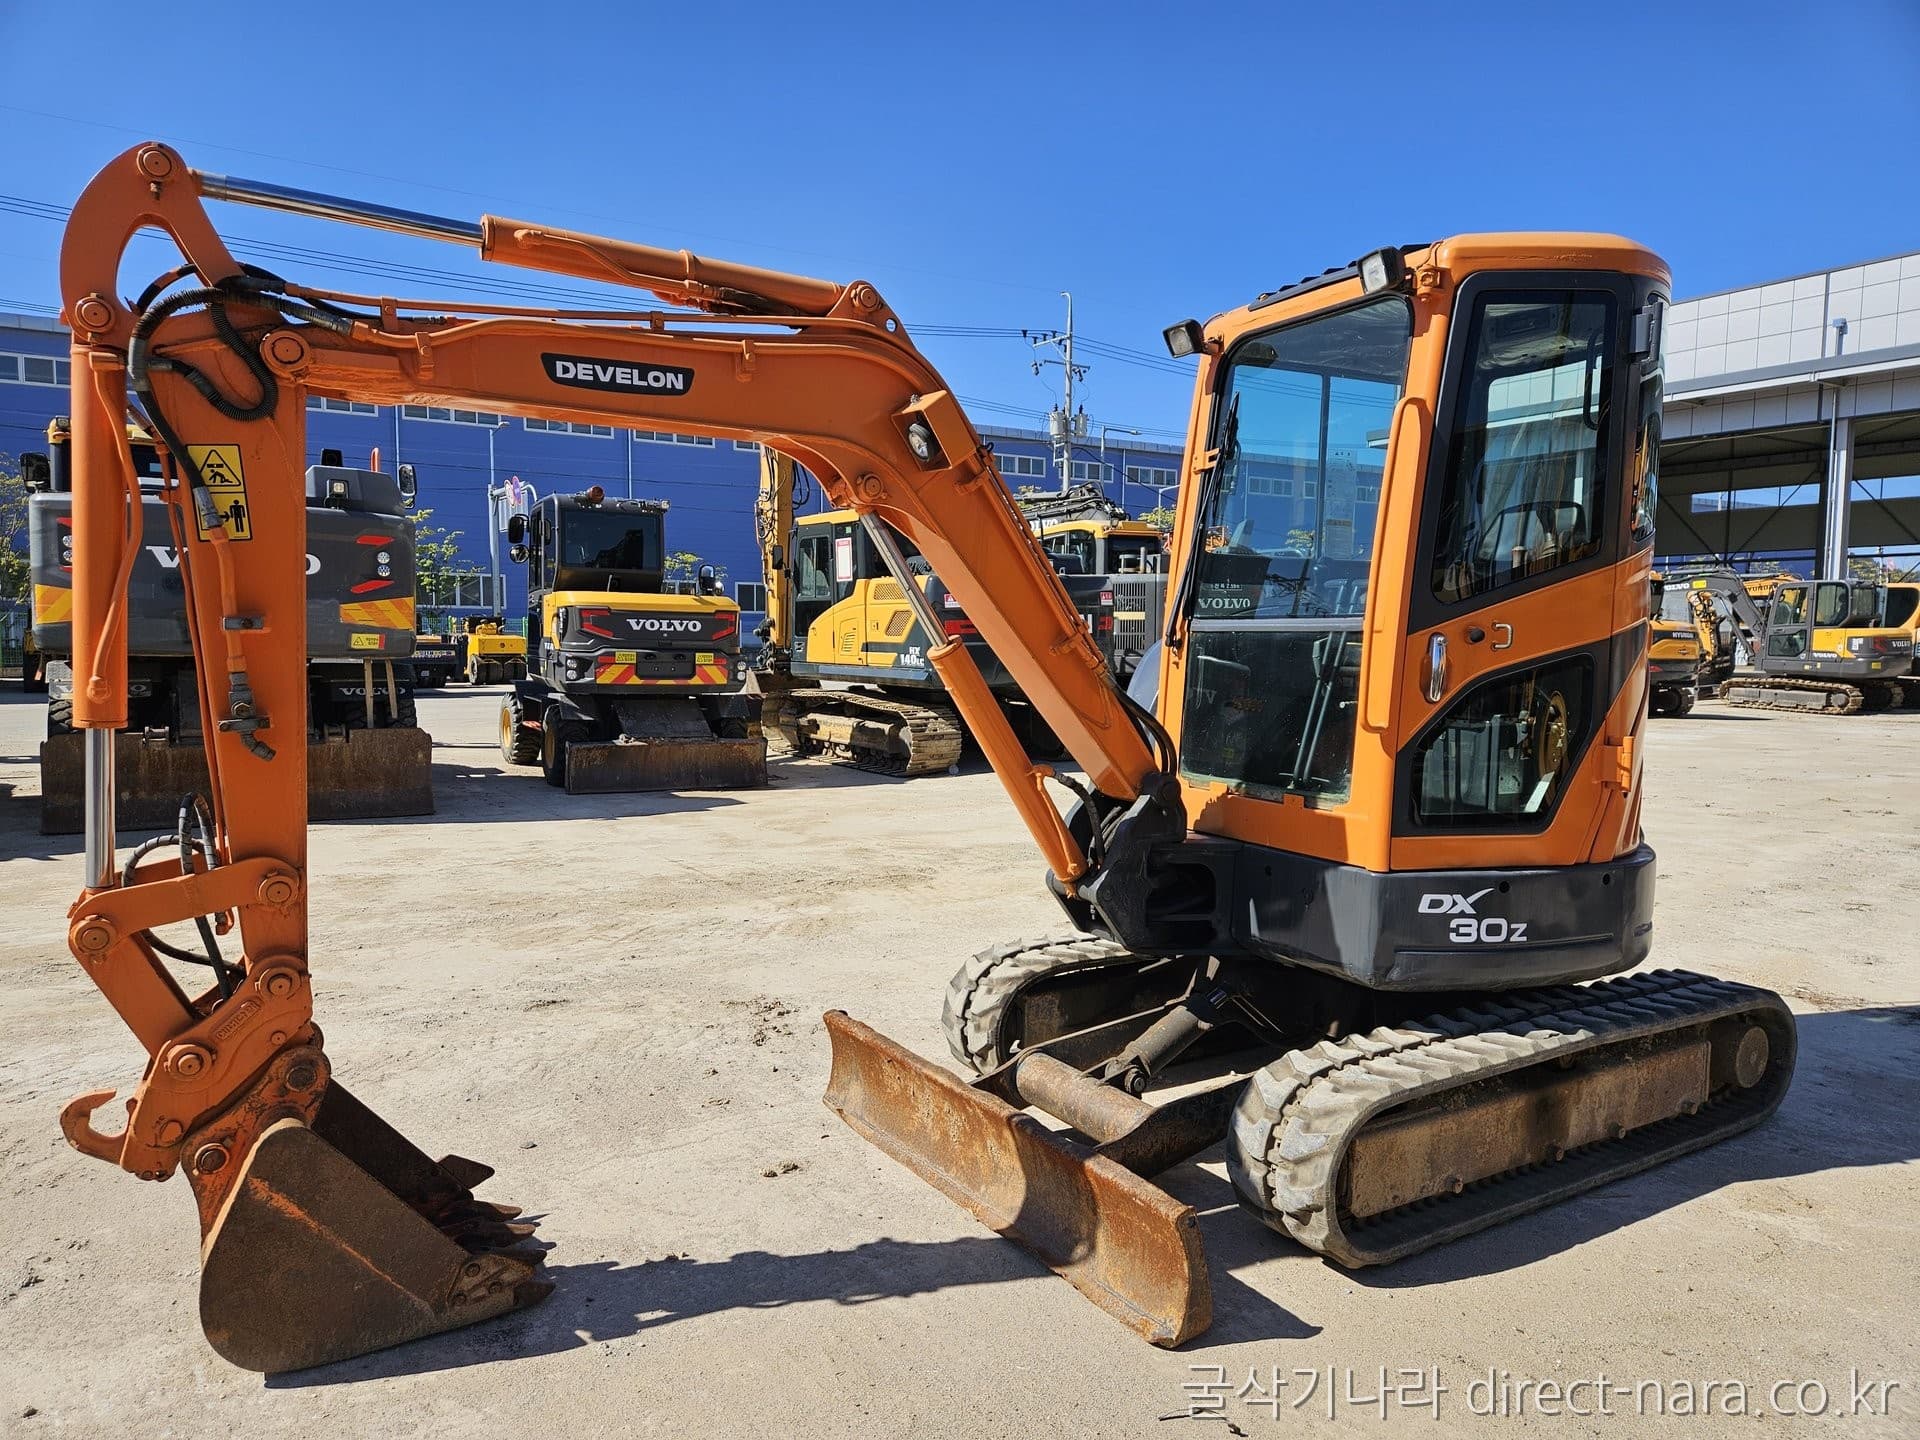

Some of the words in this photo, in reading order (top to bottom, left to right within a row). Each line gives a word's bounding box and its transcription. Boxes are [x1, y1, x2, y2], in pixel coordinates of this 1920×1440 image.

[555, 360, 684, 390] DEVELON
[1199, 598, 1251, 608] VOLVO
[627, 618, 702, 632] VOLVO
[909, 646, 920, 655] HX
[1418, 888, 1495, 914] DX
